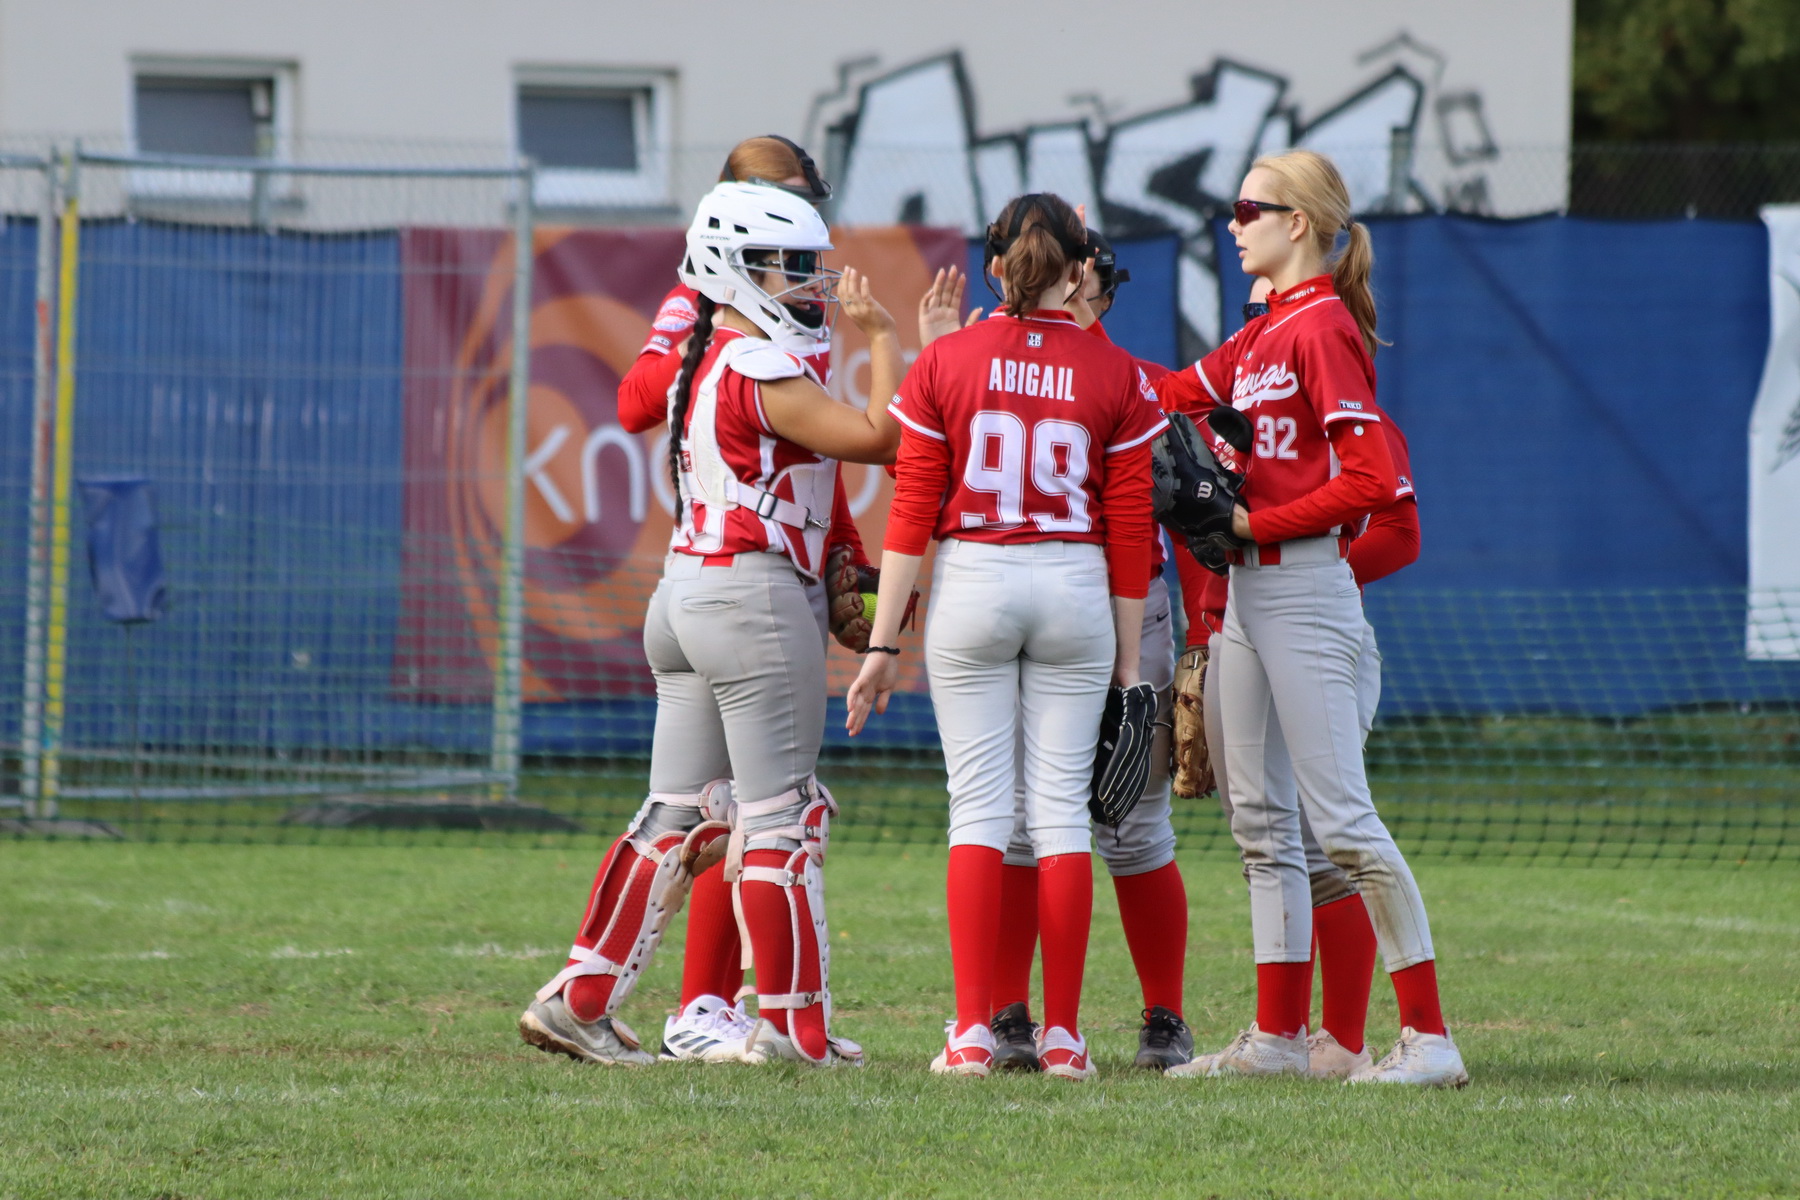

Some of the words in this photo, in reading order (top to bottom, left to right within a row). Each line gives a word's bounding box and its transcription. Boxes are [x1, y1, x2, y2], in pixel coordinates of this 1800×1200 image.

[700, 234, 731, 242] EASTON
[988, 357, 1075, 402] ABIGAIL
[1256, 415, 1298, 460] 32
[961, 410, 1092, 534] 99
